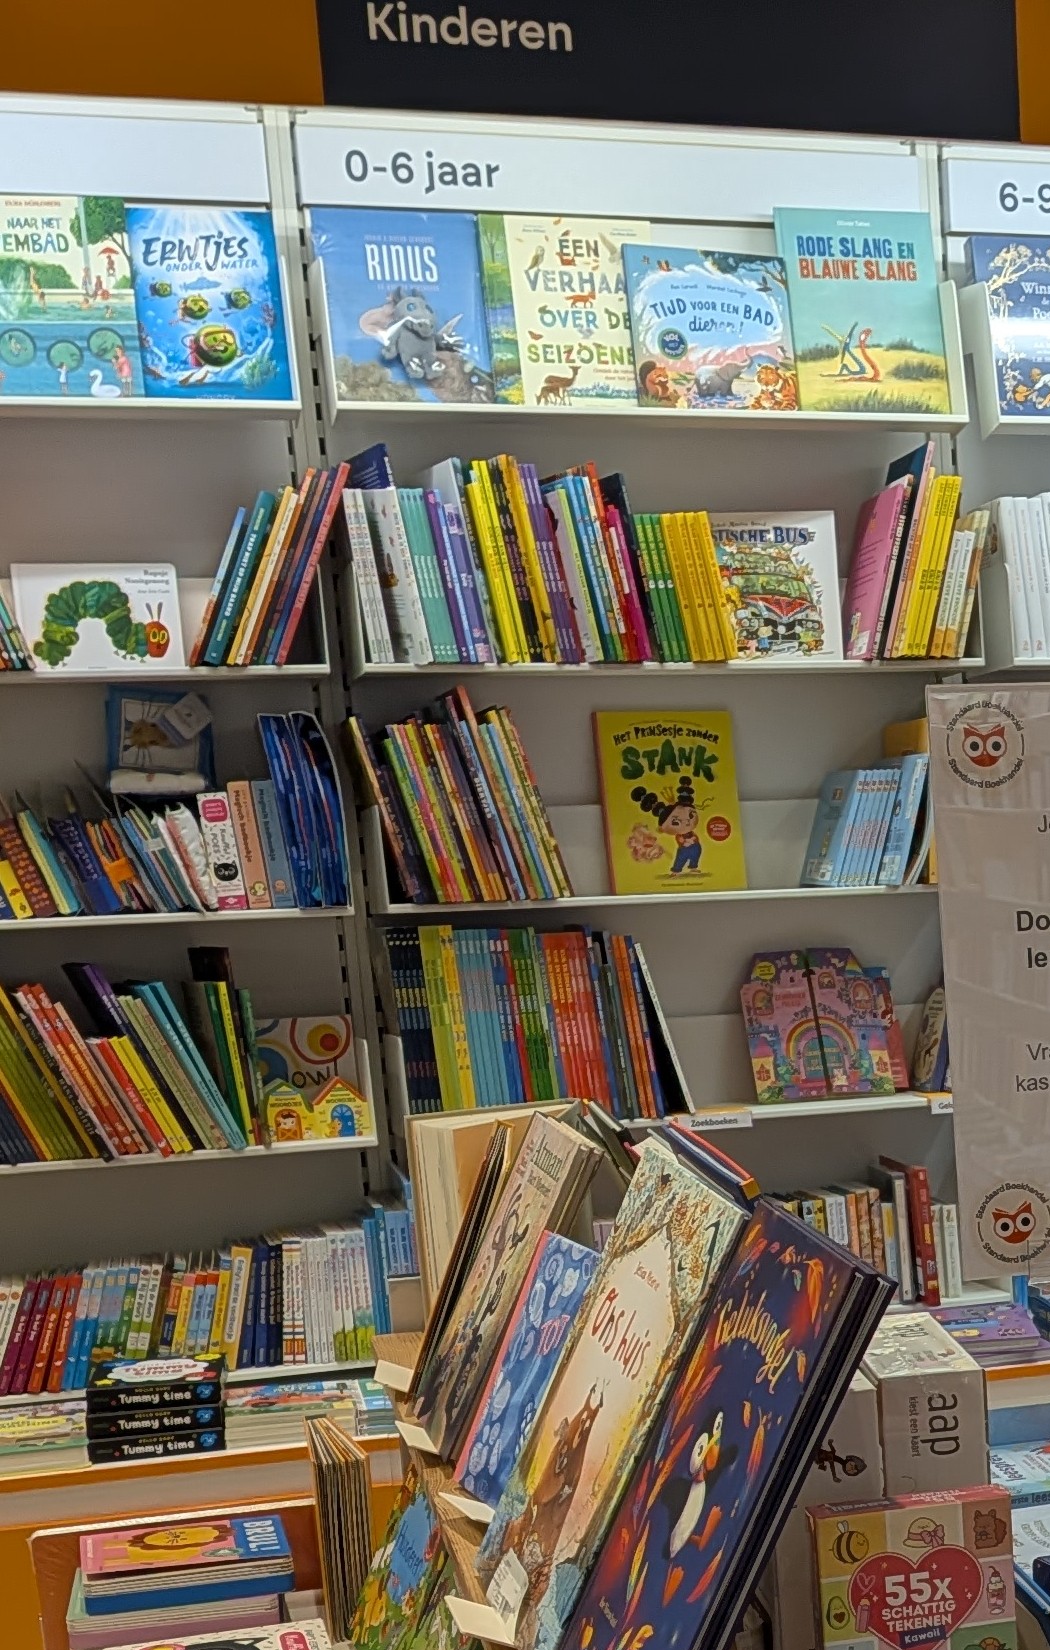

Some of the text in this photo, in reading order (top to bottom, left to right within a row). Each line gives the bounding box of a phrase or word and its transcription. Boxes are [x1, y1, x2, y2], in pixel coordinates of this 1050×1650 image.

[365, 2, 574, 53] Kinderen
[344, 148, 501, 195] 0-6 jaar
[7, 217, 62, 230] NAAR HET
[796, 235, 915, 260] RODE SLANG EN
[165, 259, 259, 272] ONDER WATER
[799, 258, 918, 281] BLAUWE SLANG
[524, 270, 626, 294] VERHAA
[539, 305, 598, 330] OVER
[651, 297, 687, 319] TIJD
[689, 300, 717, 312] VOOR
[720, 302, 739, 315] EEN
[621, 738, 719, 782] STANK
[947, 757, 1024, 789] Standaard Boekhandel
[689, 1115, 740, 1129] Zoekboeken
[1005, 1182, 1050, 1205] Boekhandel
[118, 1389, 192, 1406] Tummy time
[117, 1413, 192, 1431] Tummy time
[920, 1391, 961, 1457] aap
[121, 1438, 195, 1456] Tummy time
[883, 1569, 953, 1606] 55x
[881, 1599, 957, 1622] SCHATTIG
[886, 1613, 952, 1634] TEKENEN
